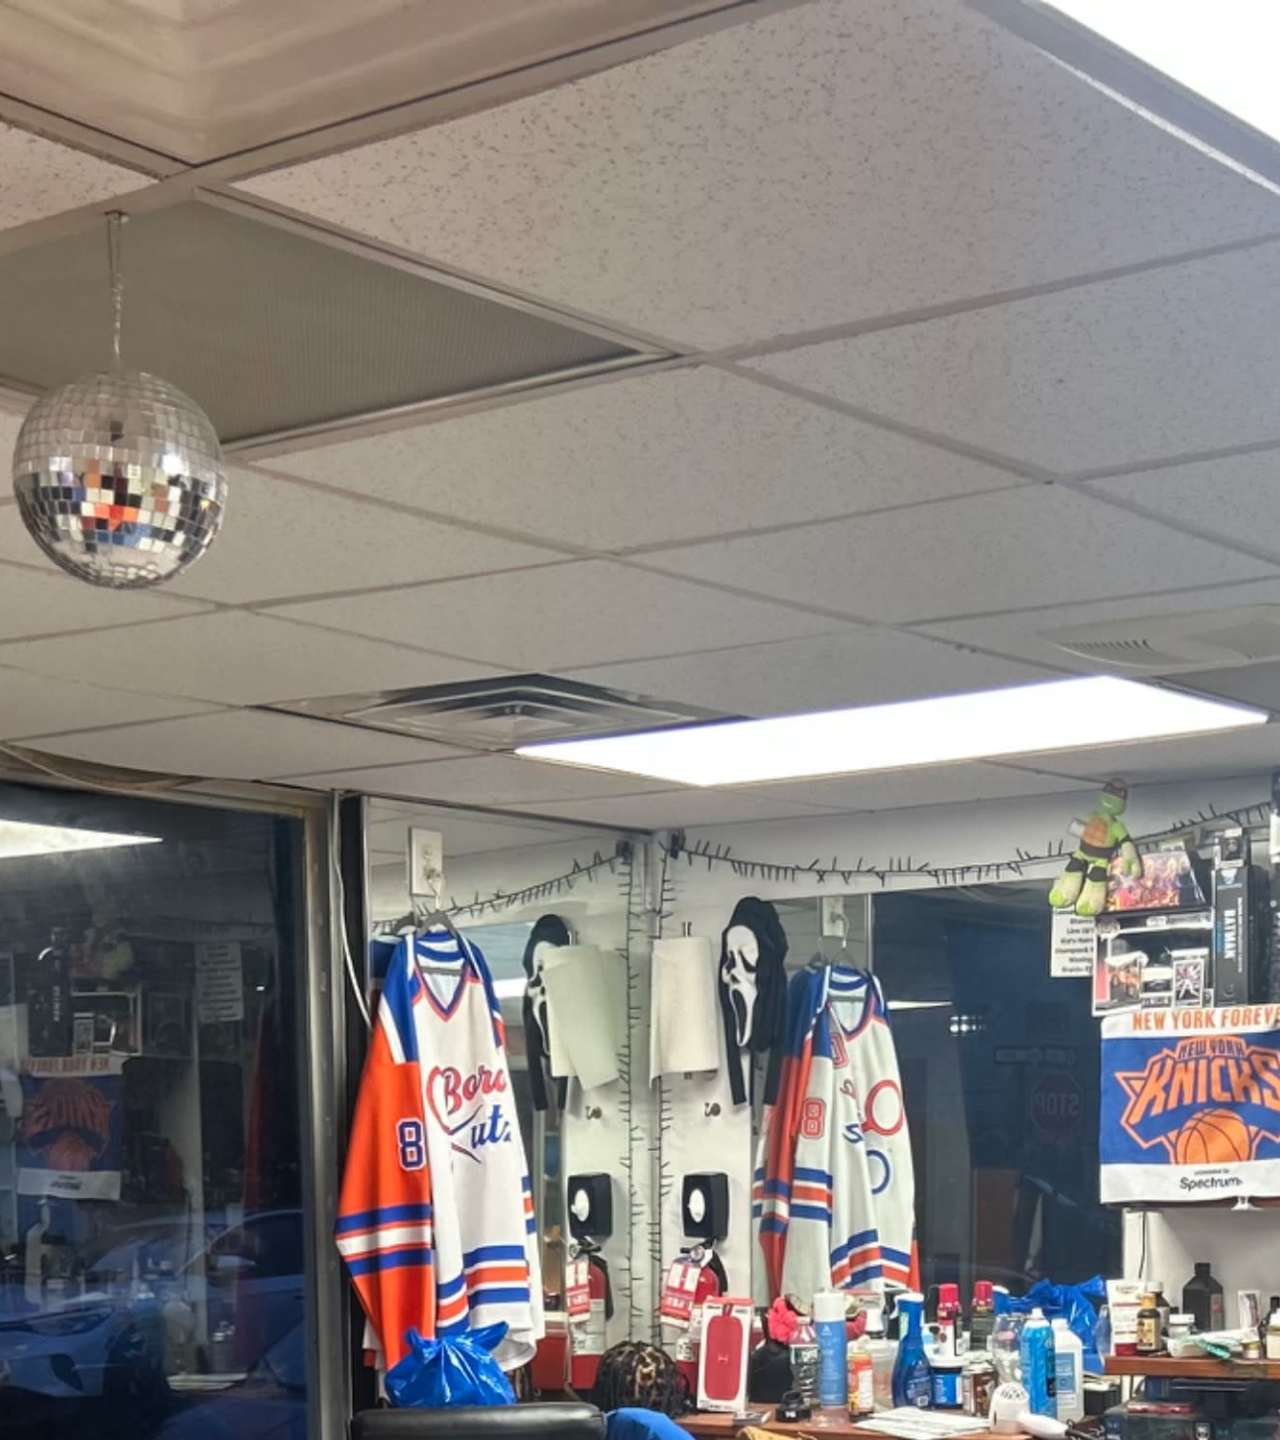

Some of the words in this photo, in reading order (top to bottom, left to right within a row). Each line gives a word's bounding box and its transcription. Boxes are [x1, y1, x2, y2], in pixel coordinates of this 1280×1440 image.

[1224, 910, 1236, 959] BATMAN
[1133, 1012, 1165, 1030] NEW
[1172, 1009, 1215, 1029] YORK
[1179, 1041, 1205, 1059] NEW
[1210, 1039, 1246, 1058] YORK
[398, 1120, 424, 1169] 8
[1179, 1176, 1239, 1192] Spectrum
